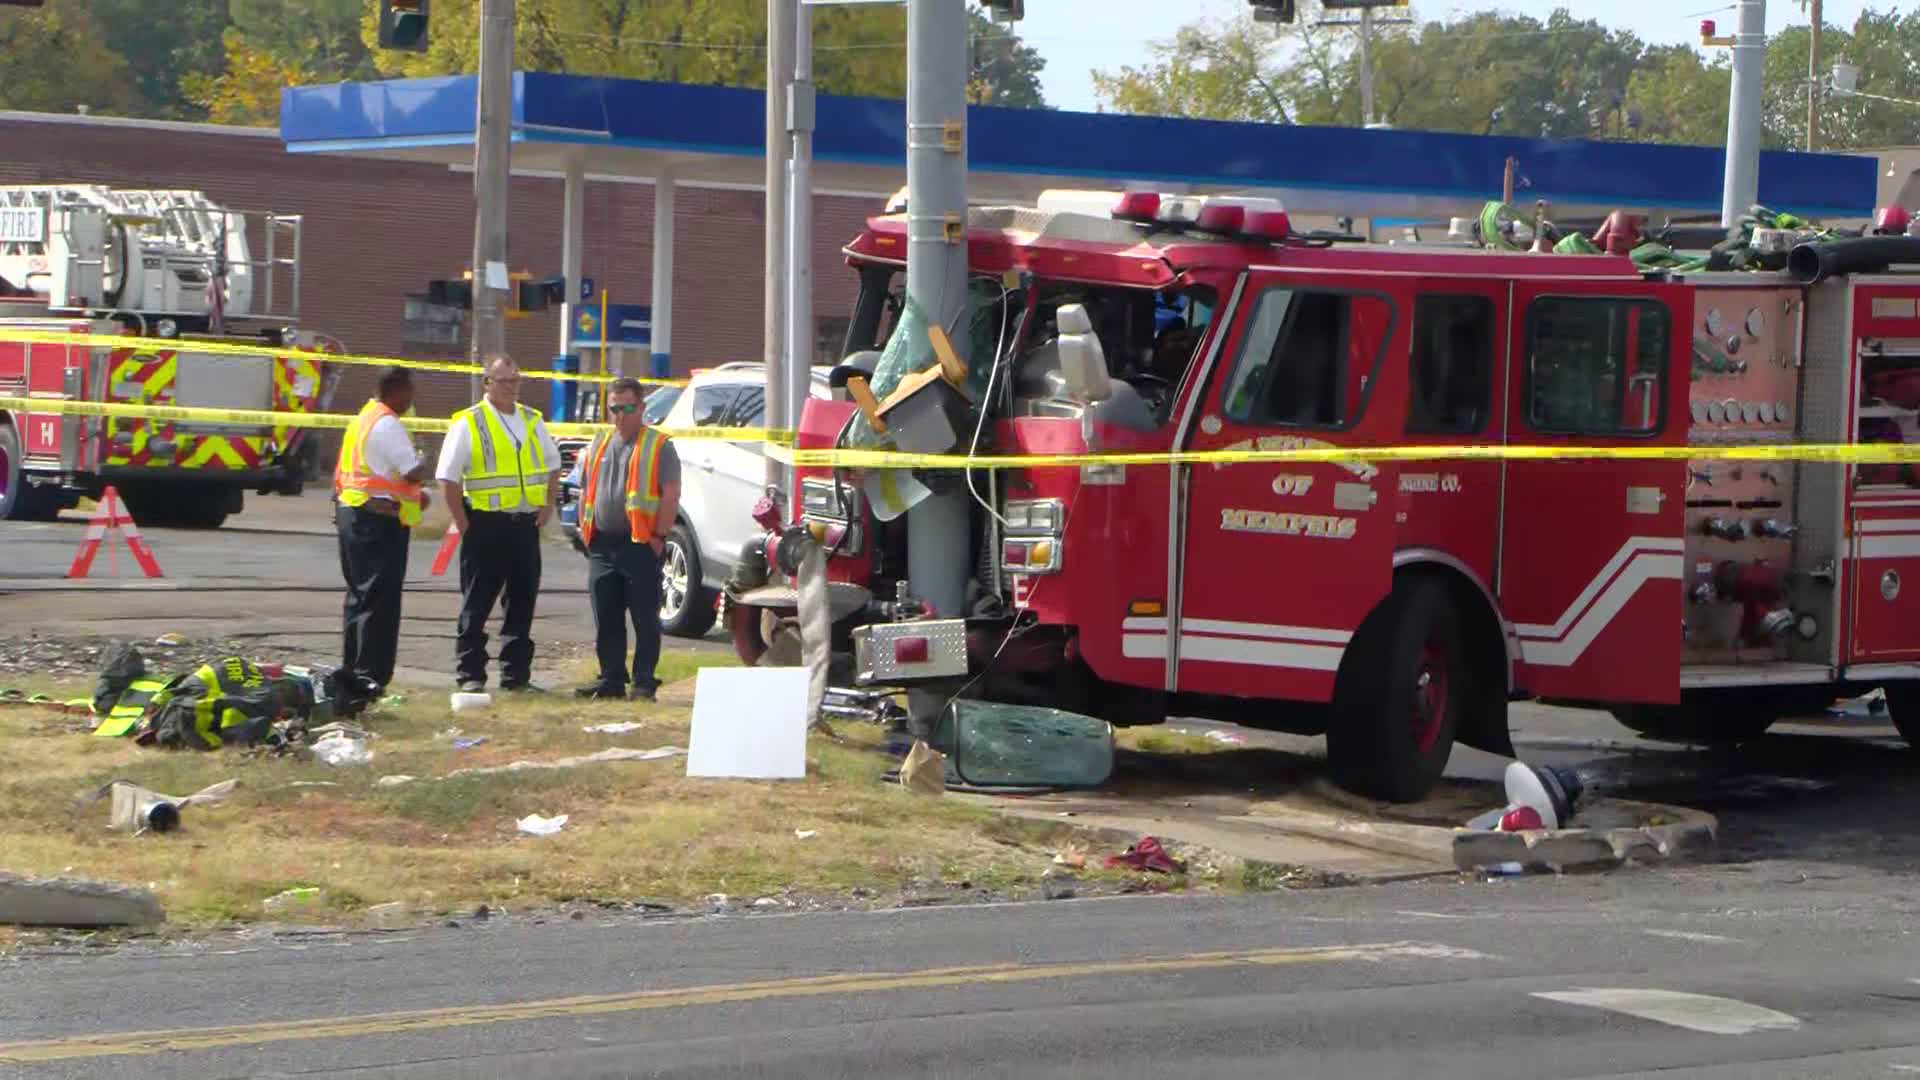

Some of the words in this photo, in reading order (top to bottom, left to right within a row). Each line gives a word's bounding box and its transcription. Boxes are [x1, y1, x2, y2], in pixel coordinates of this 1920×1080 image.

[1, 211, 37, 237] FIRE
[1272, 473, 1313, 496] OF
[1220, 508, 1357, 539] MEMPHIS
